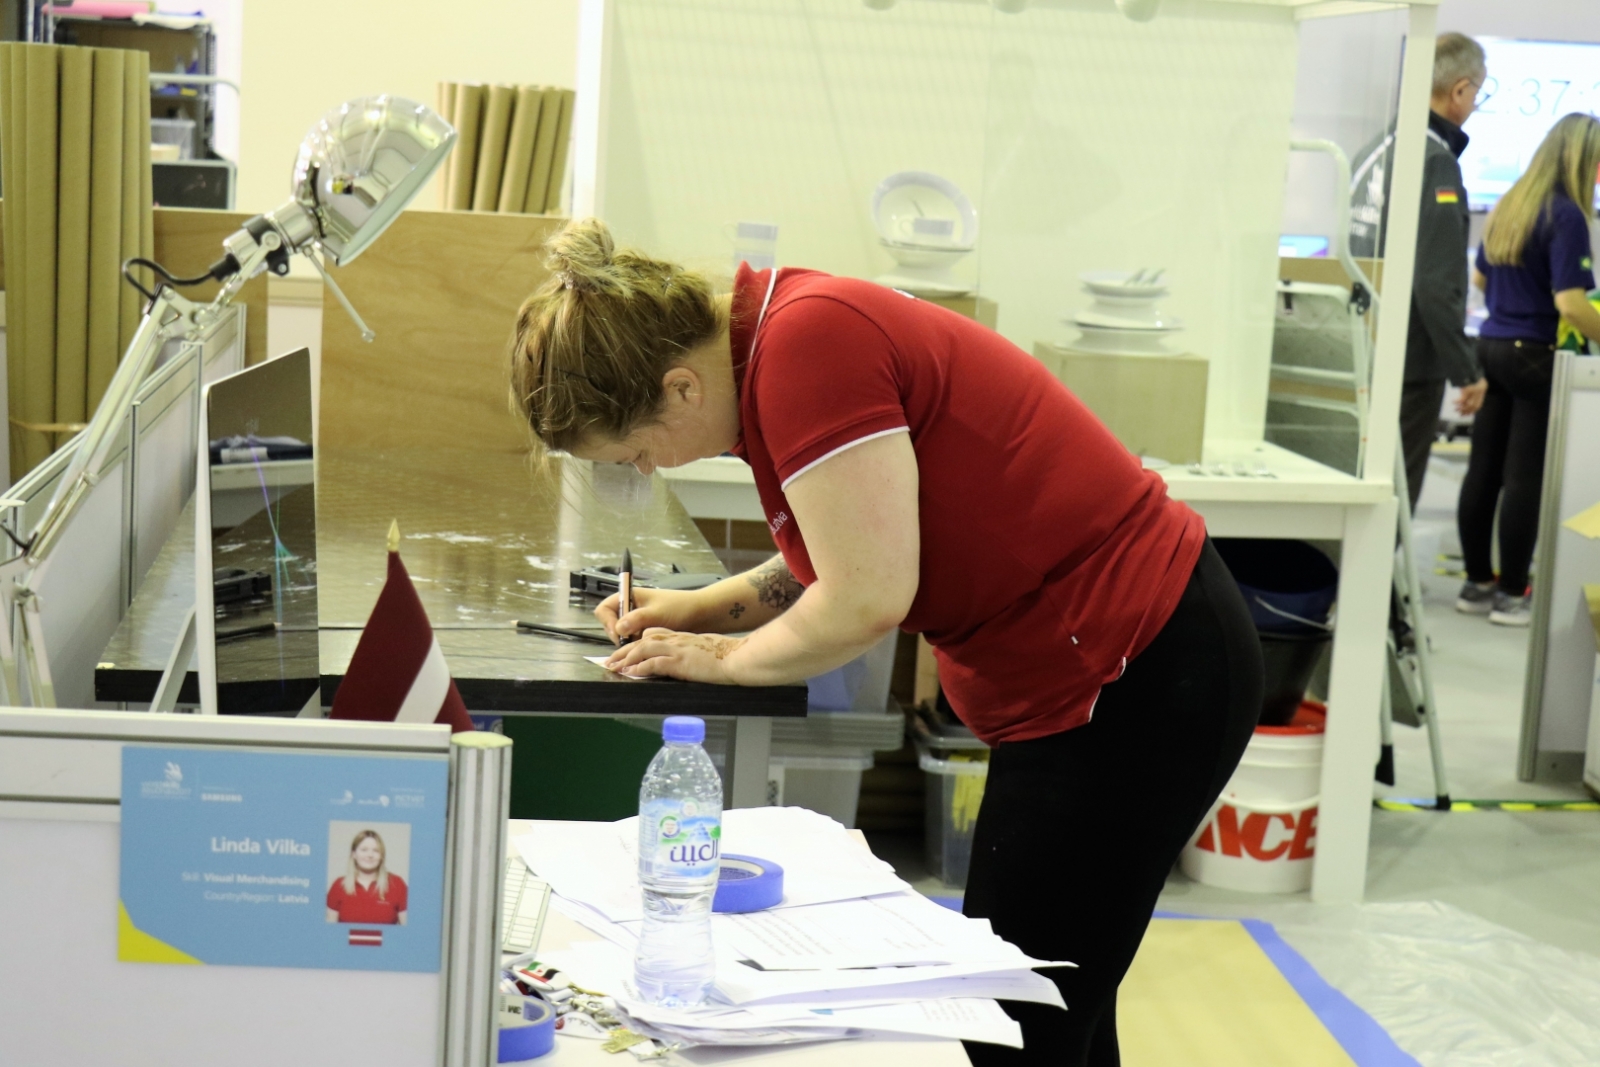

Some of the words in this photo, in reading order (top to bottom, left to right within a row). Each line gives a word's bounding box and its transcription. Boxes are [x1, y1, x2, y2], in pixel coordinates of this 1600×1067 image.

[1195, 803, 1319, 862] ACE
[211, 836, 261, 854] Linda
[266, 838, 311, 856] Vilka
[670, 838, 719, 867] العين
[203, 872, 235, 883] Visual
[237, 873, 310, 887] Merchandising
[278, 893, 310, 904] Latvia
[508, 1005, 522, 1015] 3M
